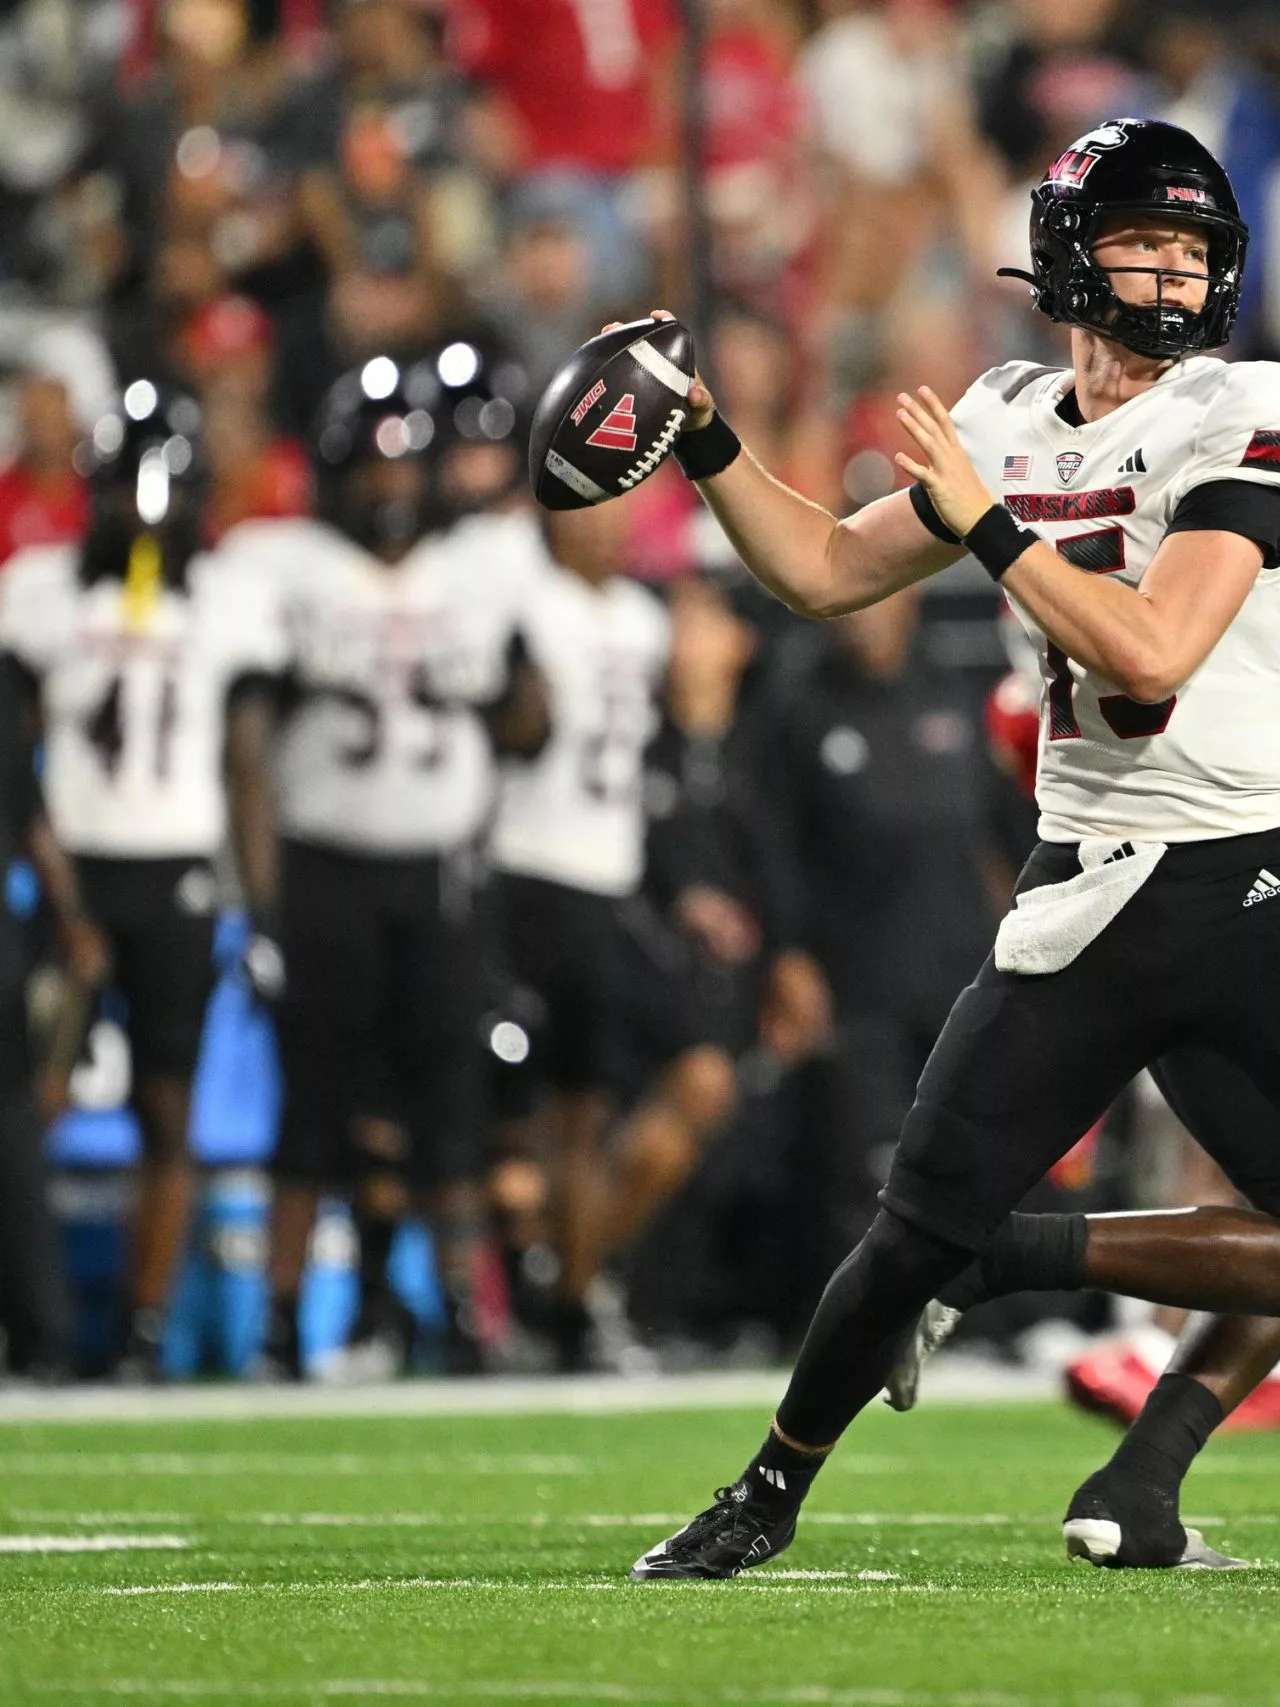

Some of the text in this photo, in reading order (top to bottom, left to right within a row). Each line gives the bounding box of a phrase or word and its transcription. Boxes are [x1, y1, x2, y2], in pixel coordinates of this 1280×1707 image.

[1166, 186, 1206, 203] NIU
[570, 379, 607, 427] DIME
[1057, 461, 1080, 470] MAC
